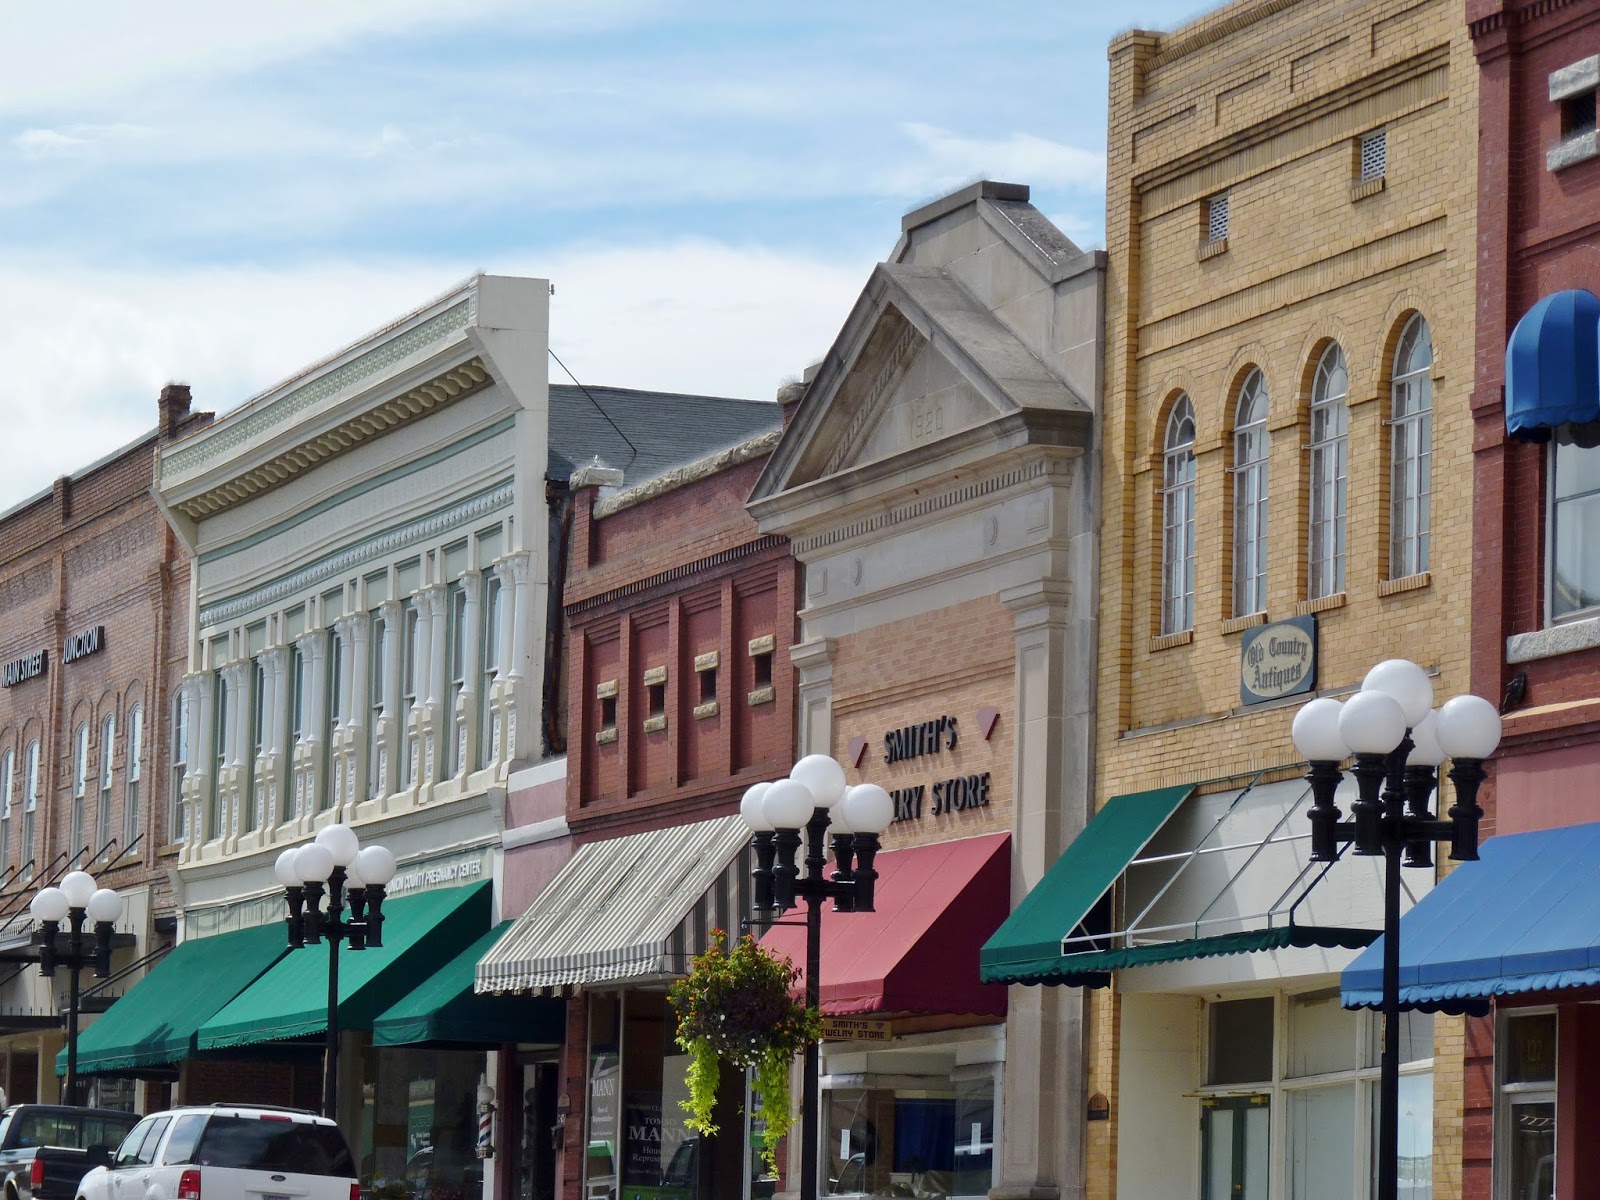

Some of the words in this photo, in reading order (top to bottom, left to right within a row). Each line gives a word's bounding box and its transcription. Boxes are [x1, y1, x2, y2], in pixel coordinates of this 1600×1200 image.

[910, 407, 944, 440] 1920
[62, 626, 101, 664] JUNCTION
[1247, 642, 1264, 667] Old
[1269, 636, 1308, 661] Country
[2, 660, 21, 688] MAIN
[20, 649, 46, 681] STREET
[1251, 662, 1302, 691] Antiques
[884, 715, 957, 764] SMITH'S
[931, 772, 990, 815] STORE
[459, 859, 481, 877] CENTER
[820, 1028, 853, 1037] EWELRY
[858, 1030, 885, 1039] STORE
[832, 1020, 868, 1029] SMITH'S
[592, 1078, 615, 1096] MANN
[411, 1115, 431, 1127] UCPC
[628, 1125, 691, 1143] MANN
